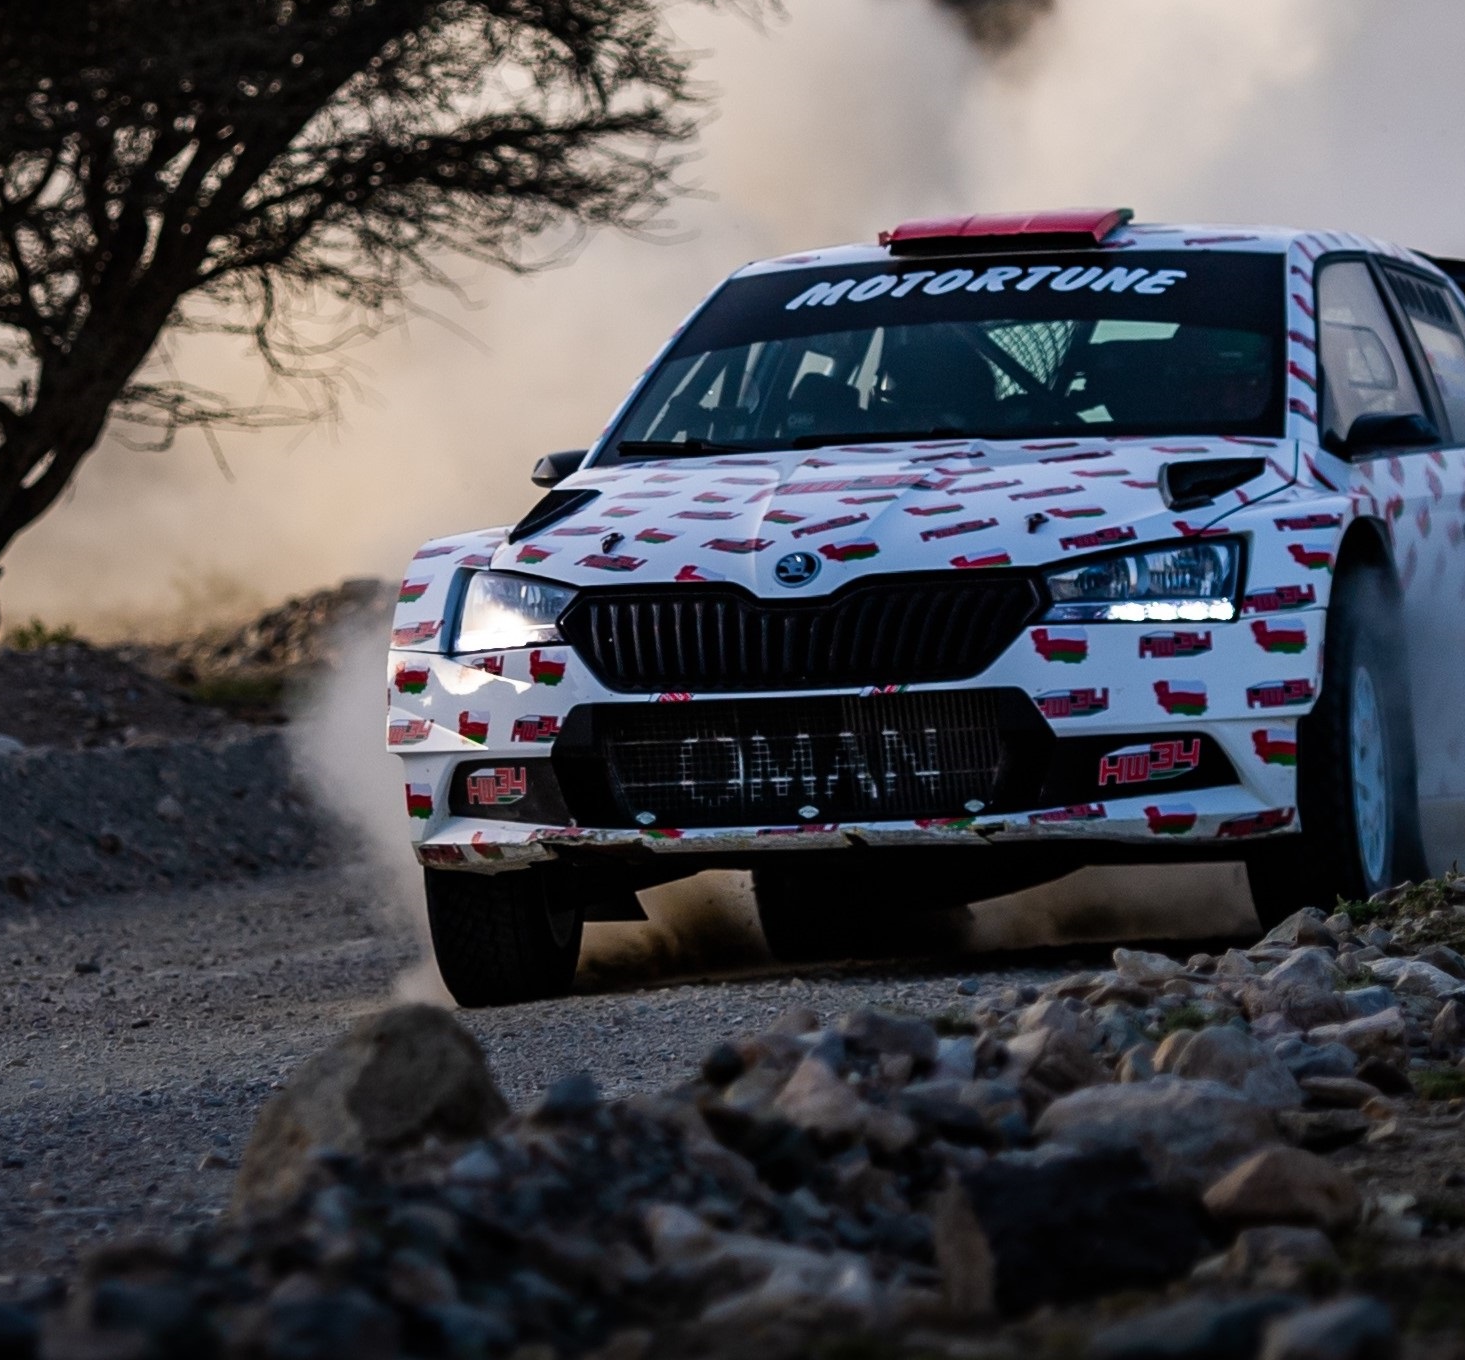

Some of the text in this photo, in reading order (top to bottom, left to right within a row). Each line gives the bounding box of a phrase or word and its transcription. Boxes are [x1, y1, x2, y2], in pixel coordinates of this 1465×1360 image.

[785, 265, 1187, 311] MOTORTUNE
[467, 766, 527, 805] HW34
[679, 728, 941, 807] OMAN
[1098, 738, 1201, 786] HW34
